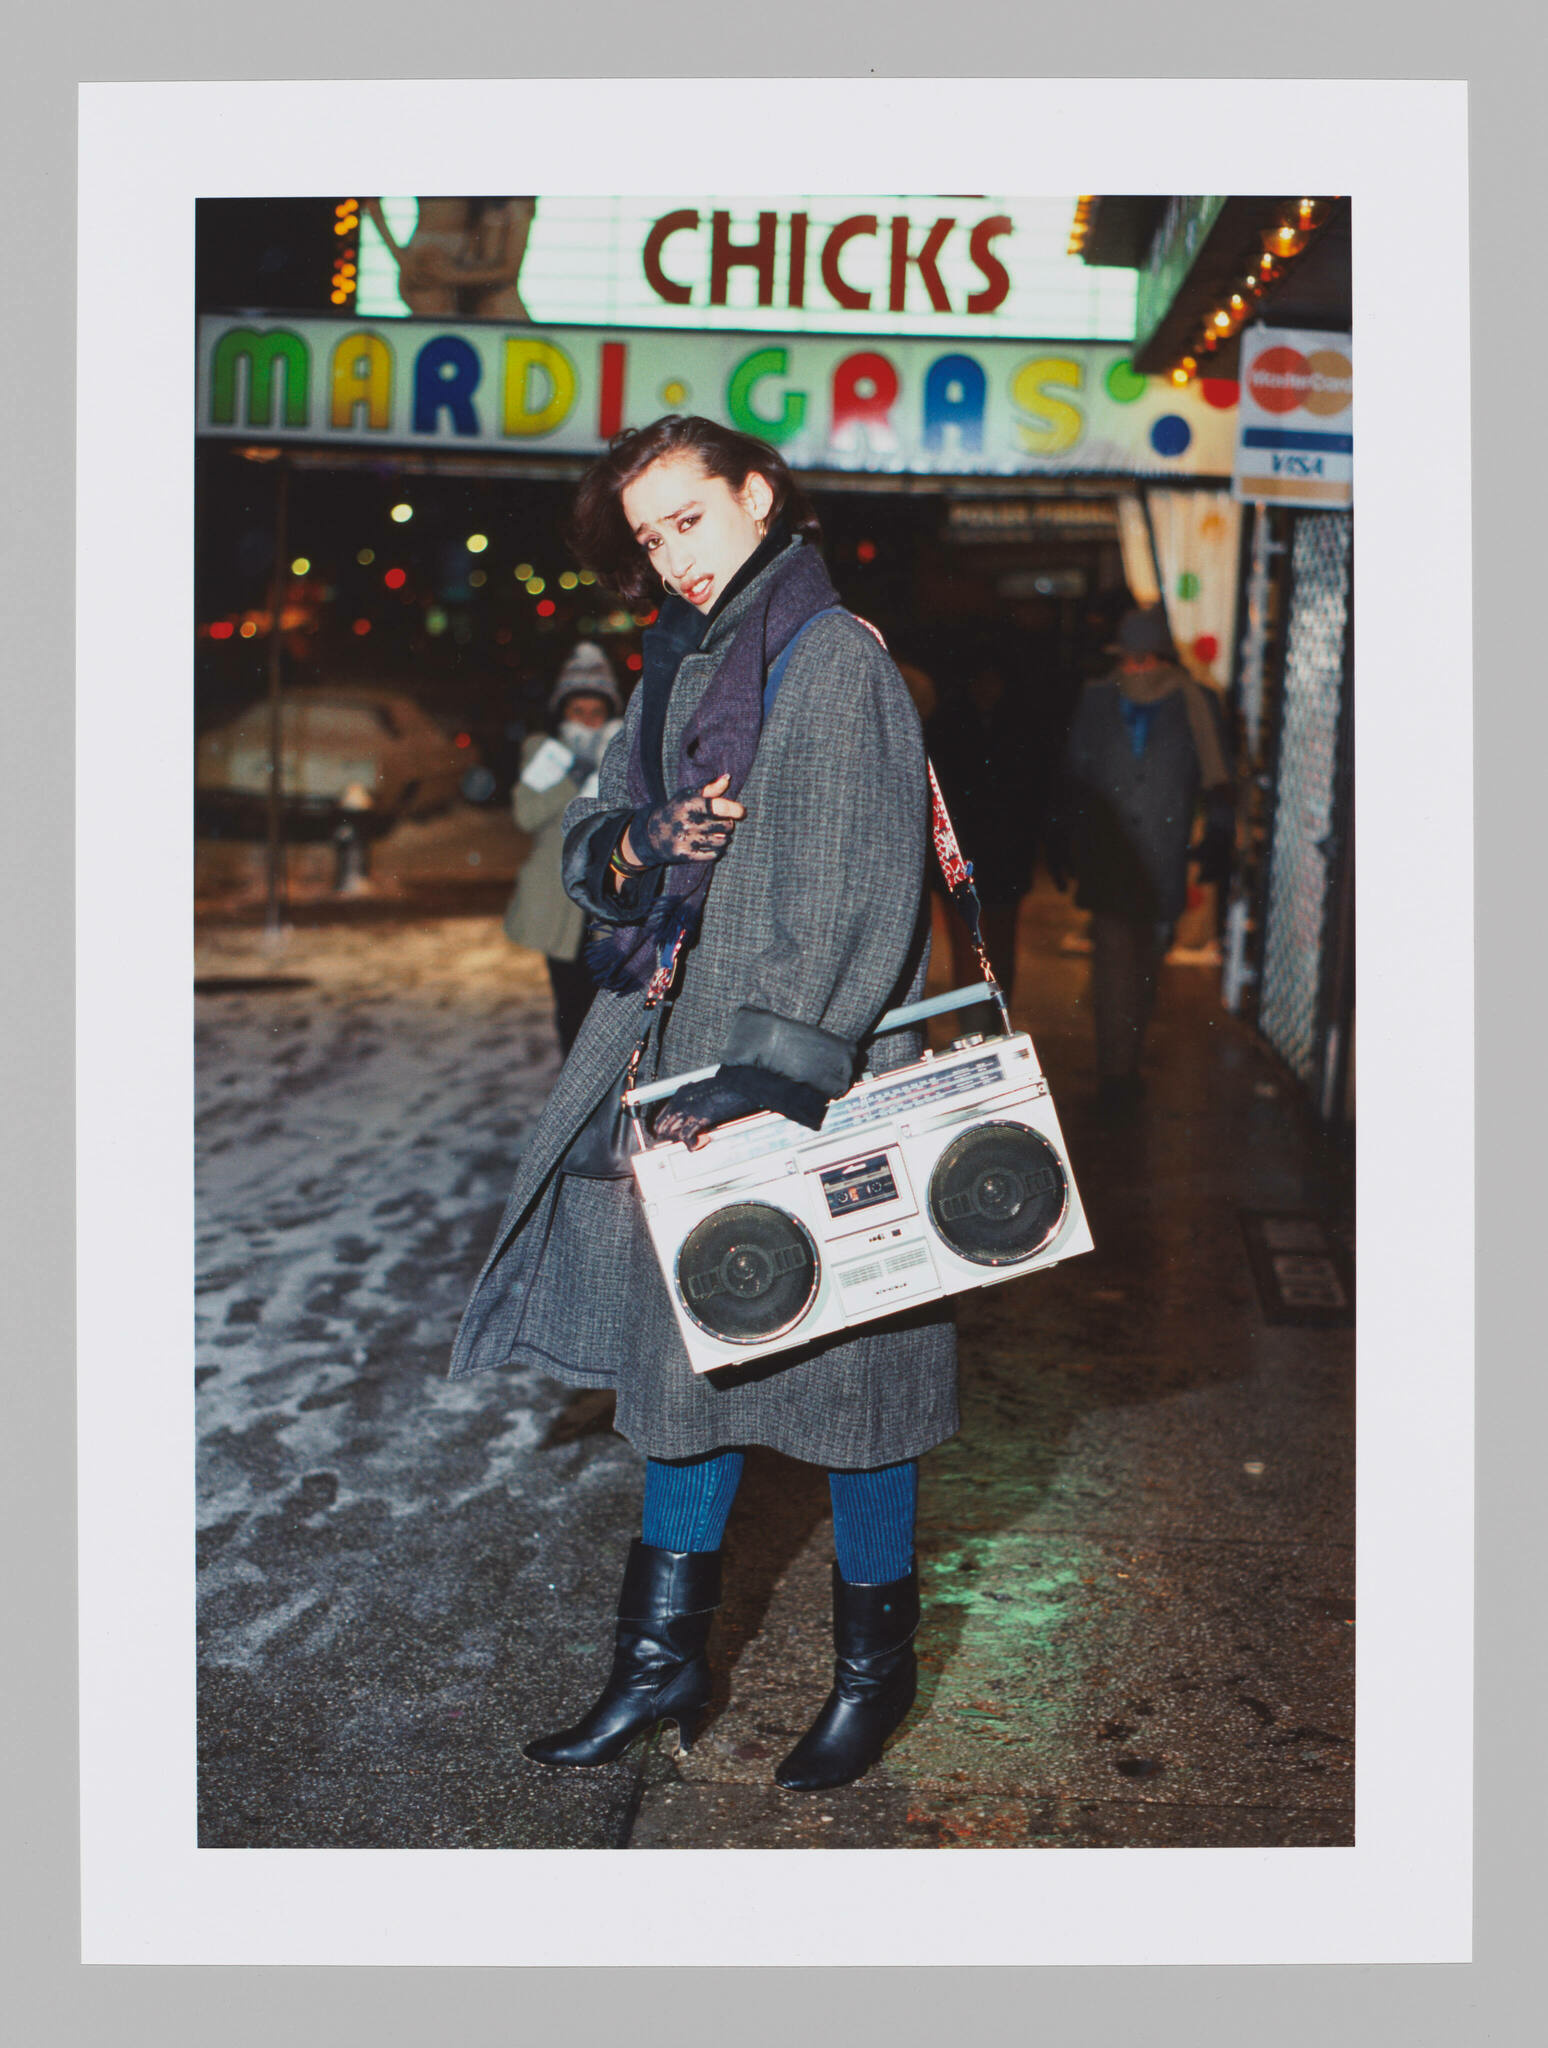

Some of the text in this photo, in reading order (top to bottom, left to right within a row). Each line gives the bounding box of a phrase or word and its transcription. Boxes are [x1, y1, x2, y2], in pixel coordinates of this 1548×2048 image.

[643, 208, 1012, 314] CHICKS
[210, 327, 1084, 456] MARDI GRAS
[1272, 454, 1323, 475] VISA
